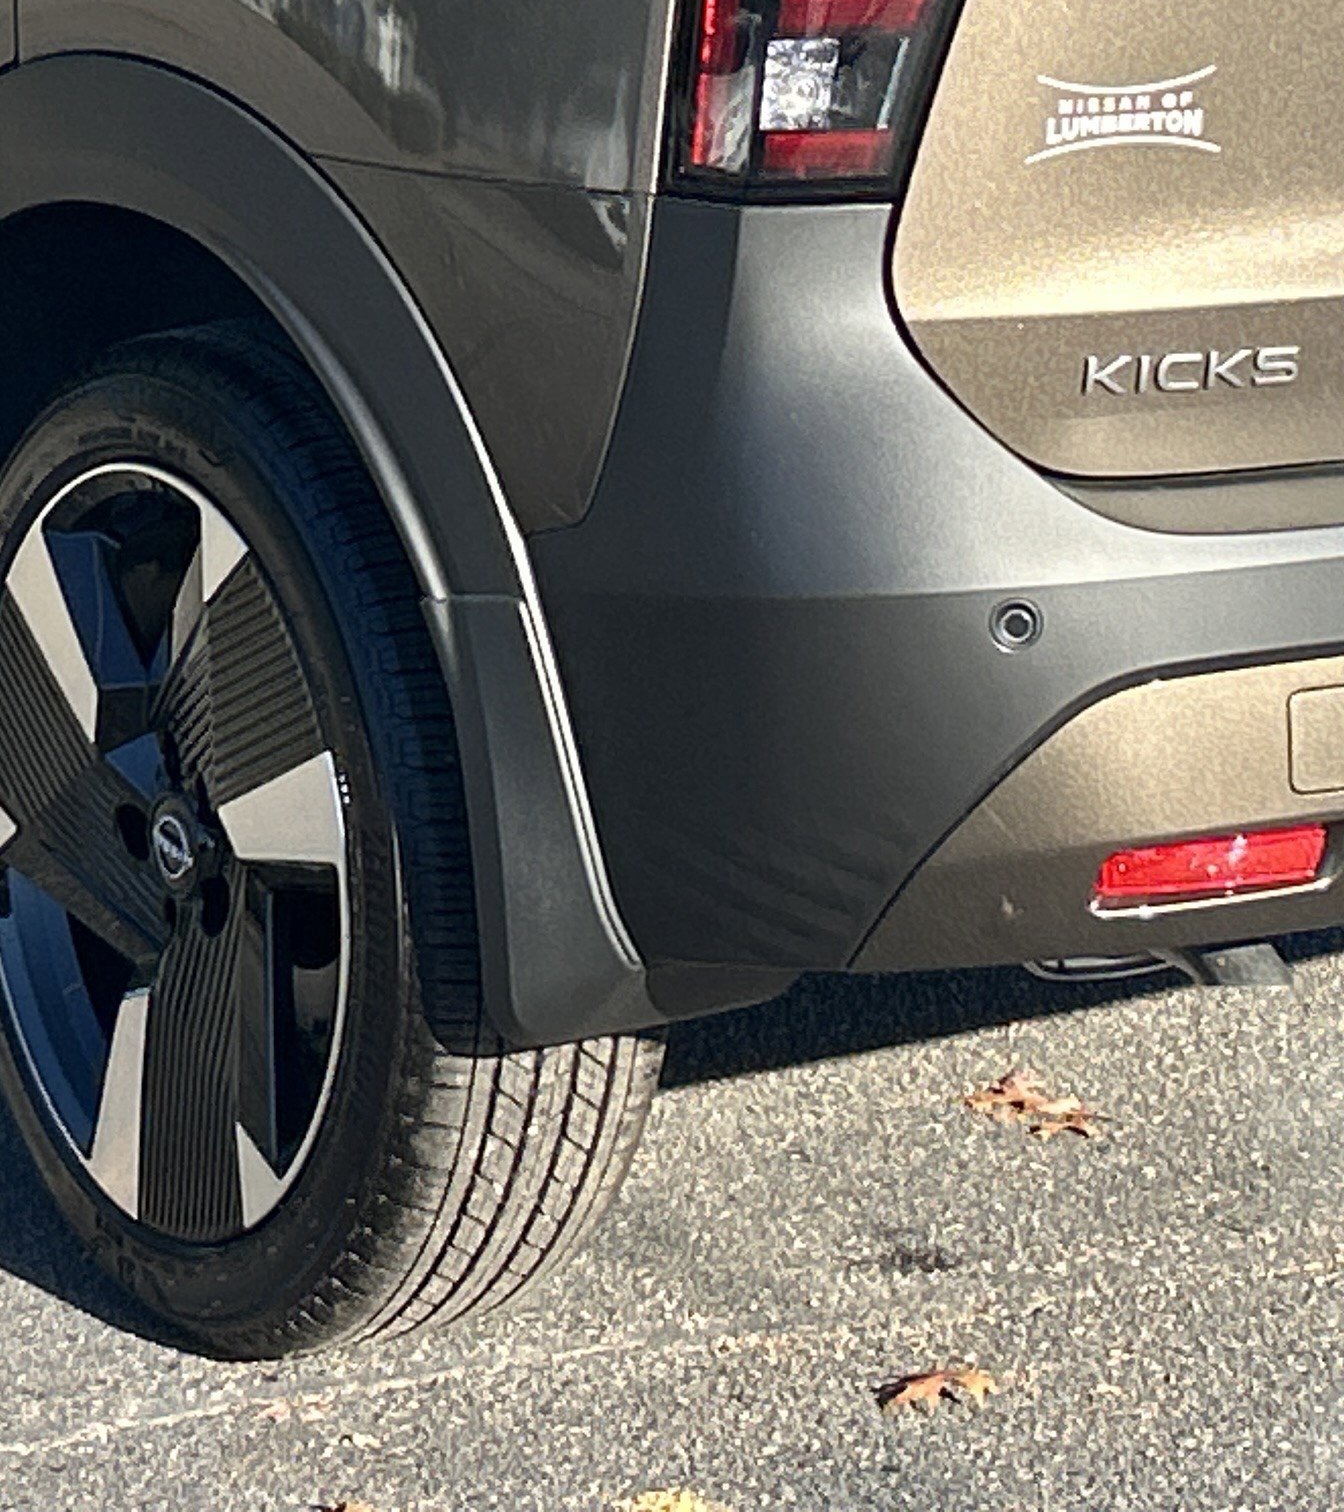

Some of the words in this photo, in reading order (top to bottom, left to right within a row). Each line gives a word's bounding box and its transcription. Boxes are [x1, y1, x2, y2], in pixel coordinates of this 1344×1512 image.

[1057, 94, 1151, 115] NISSAN
[1160, 90, 1195, 109] OF
[1045, 107, 1205, 145] LUMBERTON
[1081, 345, 1301, 396] KICKS
